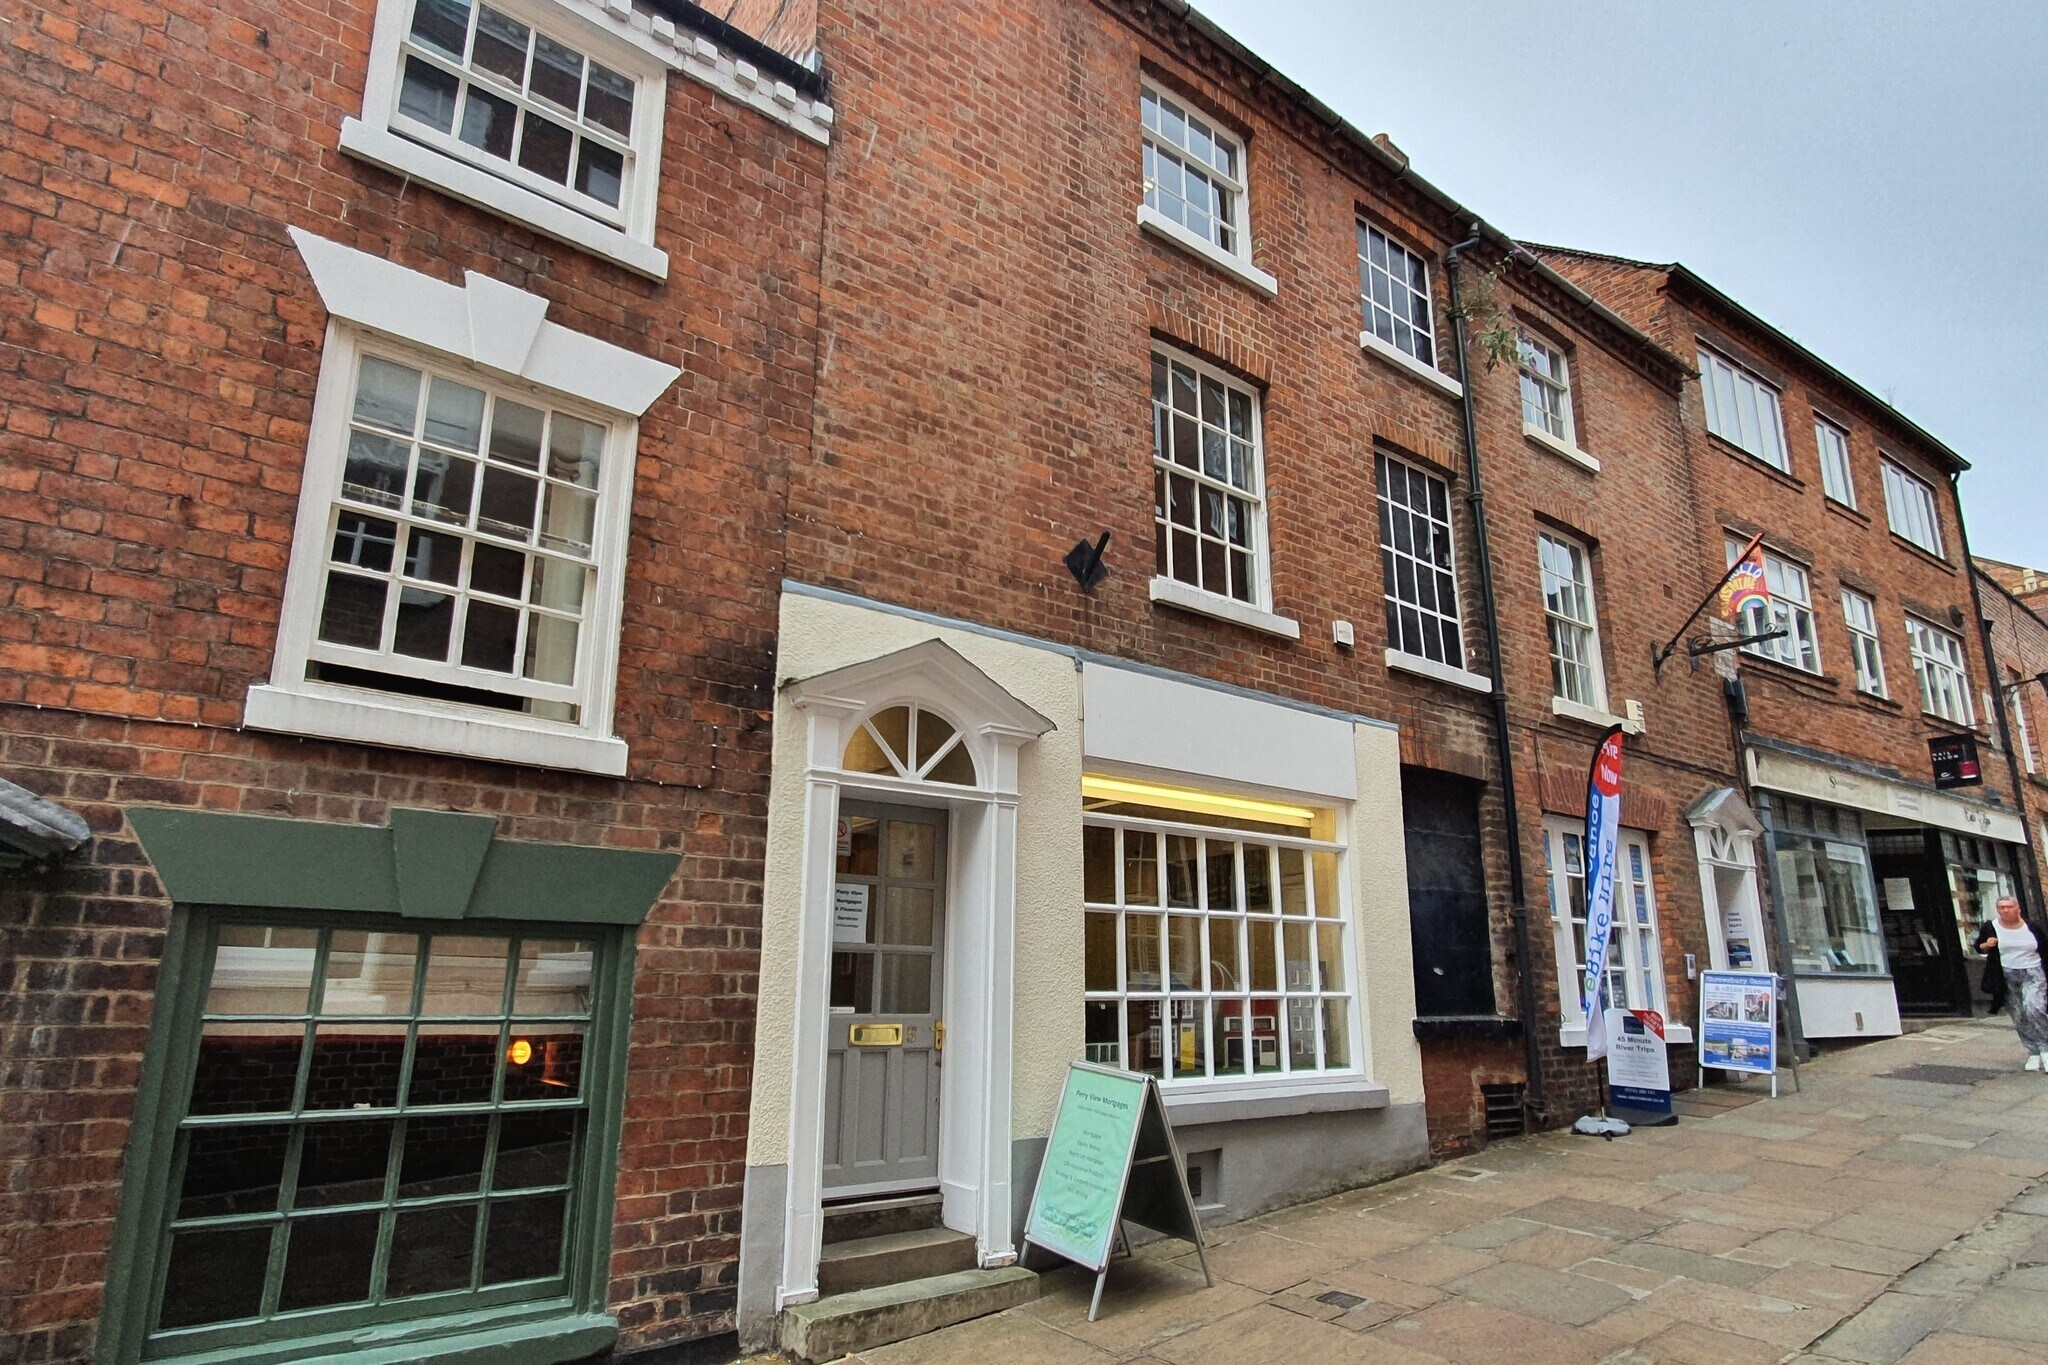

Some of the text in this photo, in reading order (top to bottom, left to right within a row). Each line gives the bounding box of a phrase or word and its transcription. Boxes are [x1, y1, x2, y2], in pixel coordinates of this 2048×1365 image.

[1600, 763, 1618, 785] Now
[1584, 911, 1610, 993] eBike
[1627, 1036, 1652, 1045] Minute
[1636, 1045, 1655, 1053] Trips
[1089, 1093, 1102, 1103] View
[1102, 1096, 1129, 1110] Mortgages
